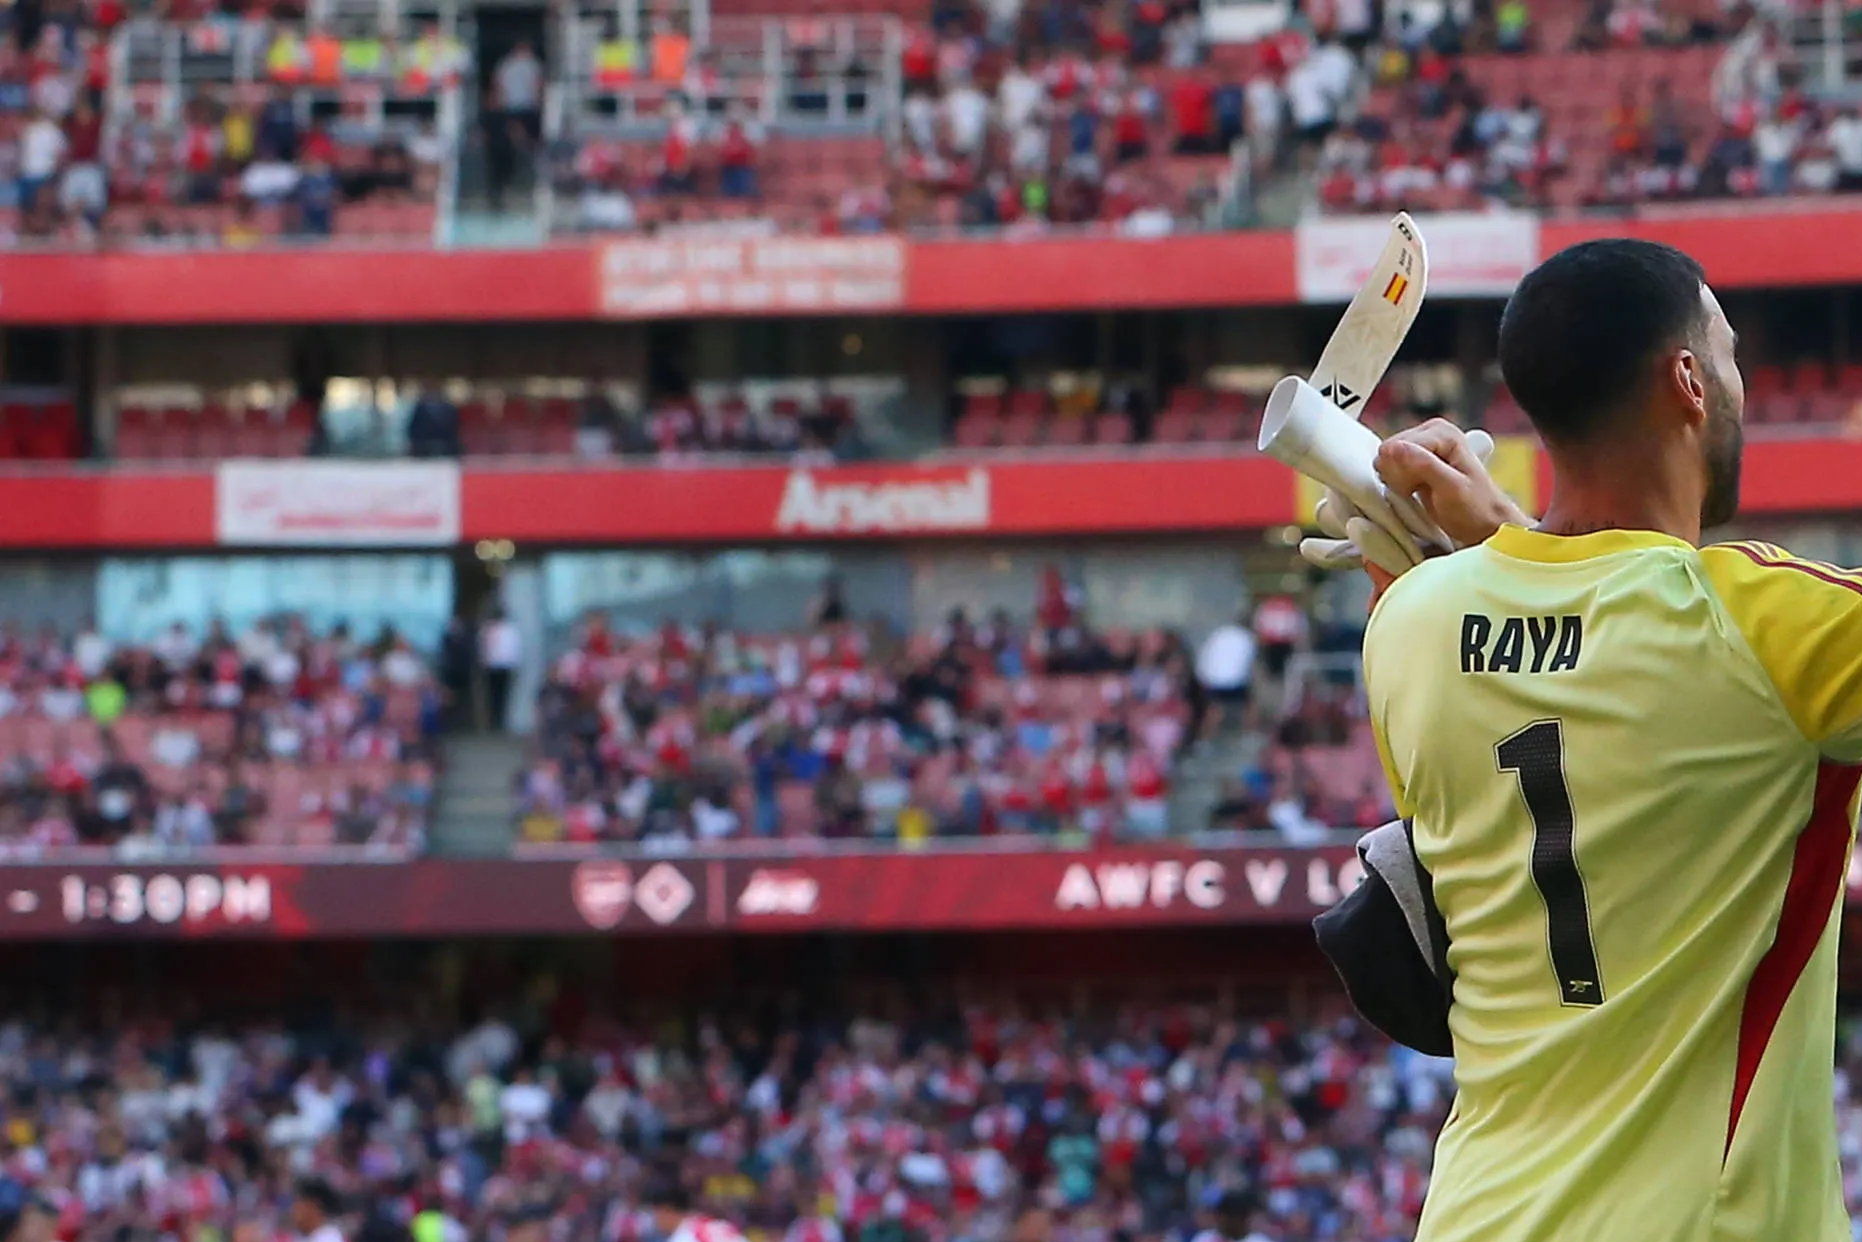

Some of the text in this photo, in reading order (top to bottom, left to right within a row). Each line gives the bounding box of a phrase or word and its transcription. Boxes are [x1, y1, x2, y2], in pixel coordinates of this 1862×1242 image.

[776, 464, 989, 534] Arsenal
[1460, 614, 1583, 673] RAYA
[1053, 860, 1227, 911] AWFC
[1244, 857, 1289, 907] V
[1493, 717, 1606, 1009] 1
[60, 873, 272, 924] 1:30PM
